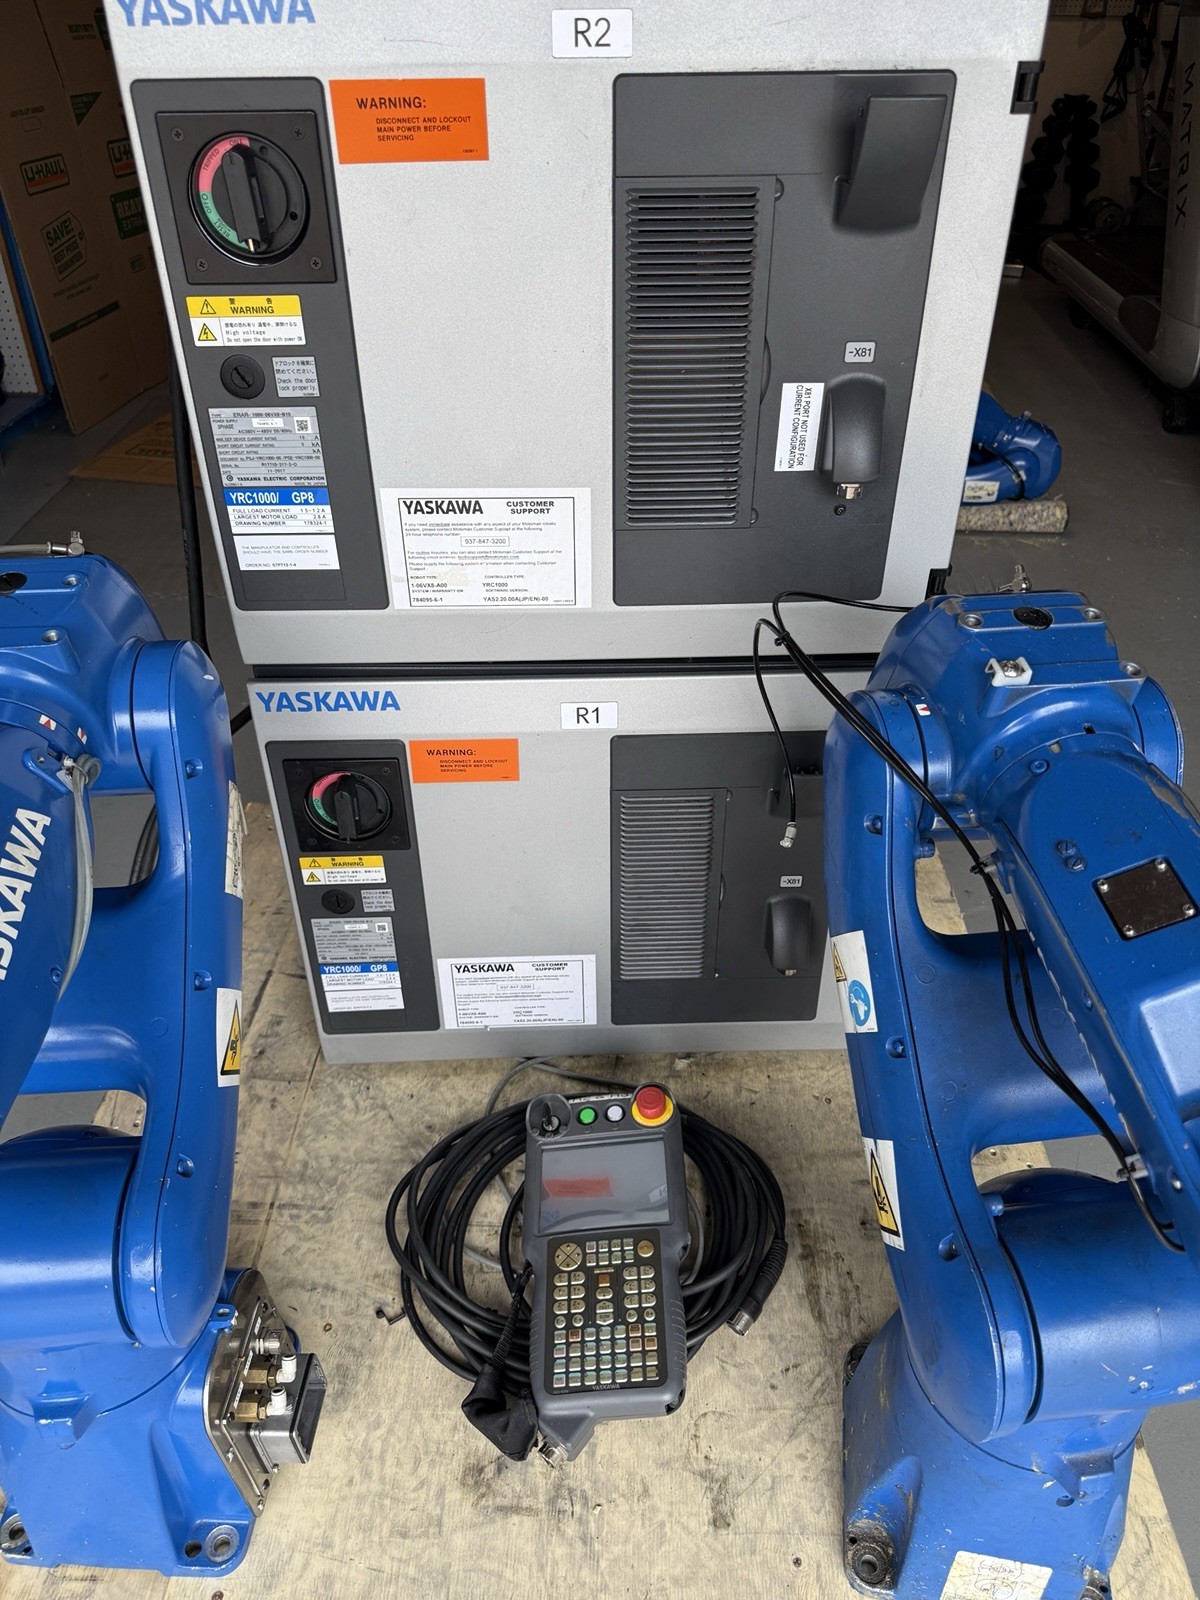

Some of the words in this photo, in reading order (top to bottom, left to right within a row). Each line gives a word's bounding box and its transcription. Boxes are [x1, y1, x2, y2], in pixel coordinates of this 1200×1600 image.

[118, 0, 316, 27] YASKAWA
[574, 17, 611, 48] R2
[356, 96, 427, 110] WARNING:
[375, 116, 420, 125] DISCONNECT
[1174, 61, 1196, 226] MATRIX
[202, 148, 220, 171] TRIPPED
[23, 159, 65, 182] U-HAUL
[45, 217, 74, 246] SAVE!
[213, 220, 231, 238] RESET
[230, 305, 275, 314] WARNING
[848, 348, 872, 357] -X81
[292, 384, 317, 392] properly.
[793, 384, 804, 416] CURRENT
[801, 400, 811, 419] PORT
[800, 419, 809, 434] NOT
[787, 416, 801, 470] CONFIGURATION
[797, 434, 807, 452] USED
[796, 452, 805, 467] FOR
[229, 492, 279, 504] YRC1000/
[291, 491, 315, 504] GP8
[402, 499, 484, 515] YASKAWA
[255, 690, 401, 712] YASKAWA
[576, 706, 599, 724] R1
[323, 965, 362, 974] YRC1000/
[370, 964, 388, 972] GP8
[454, 963, 515, 974] YASKAWA
